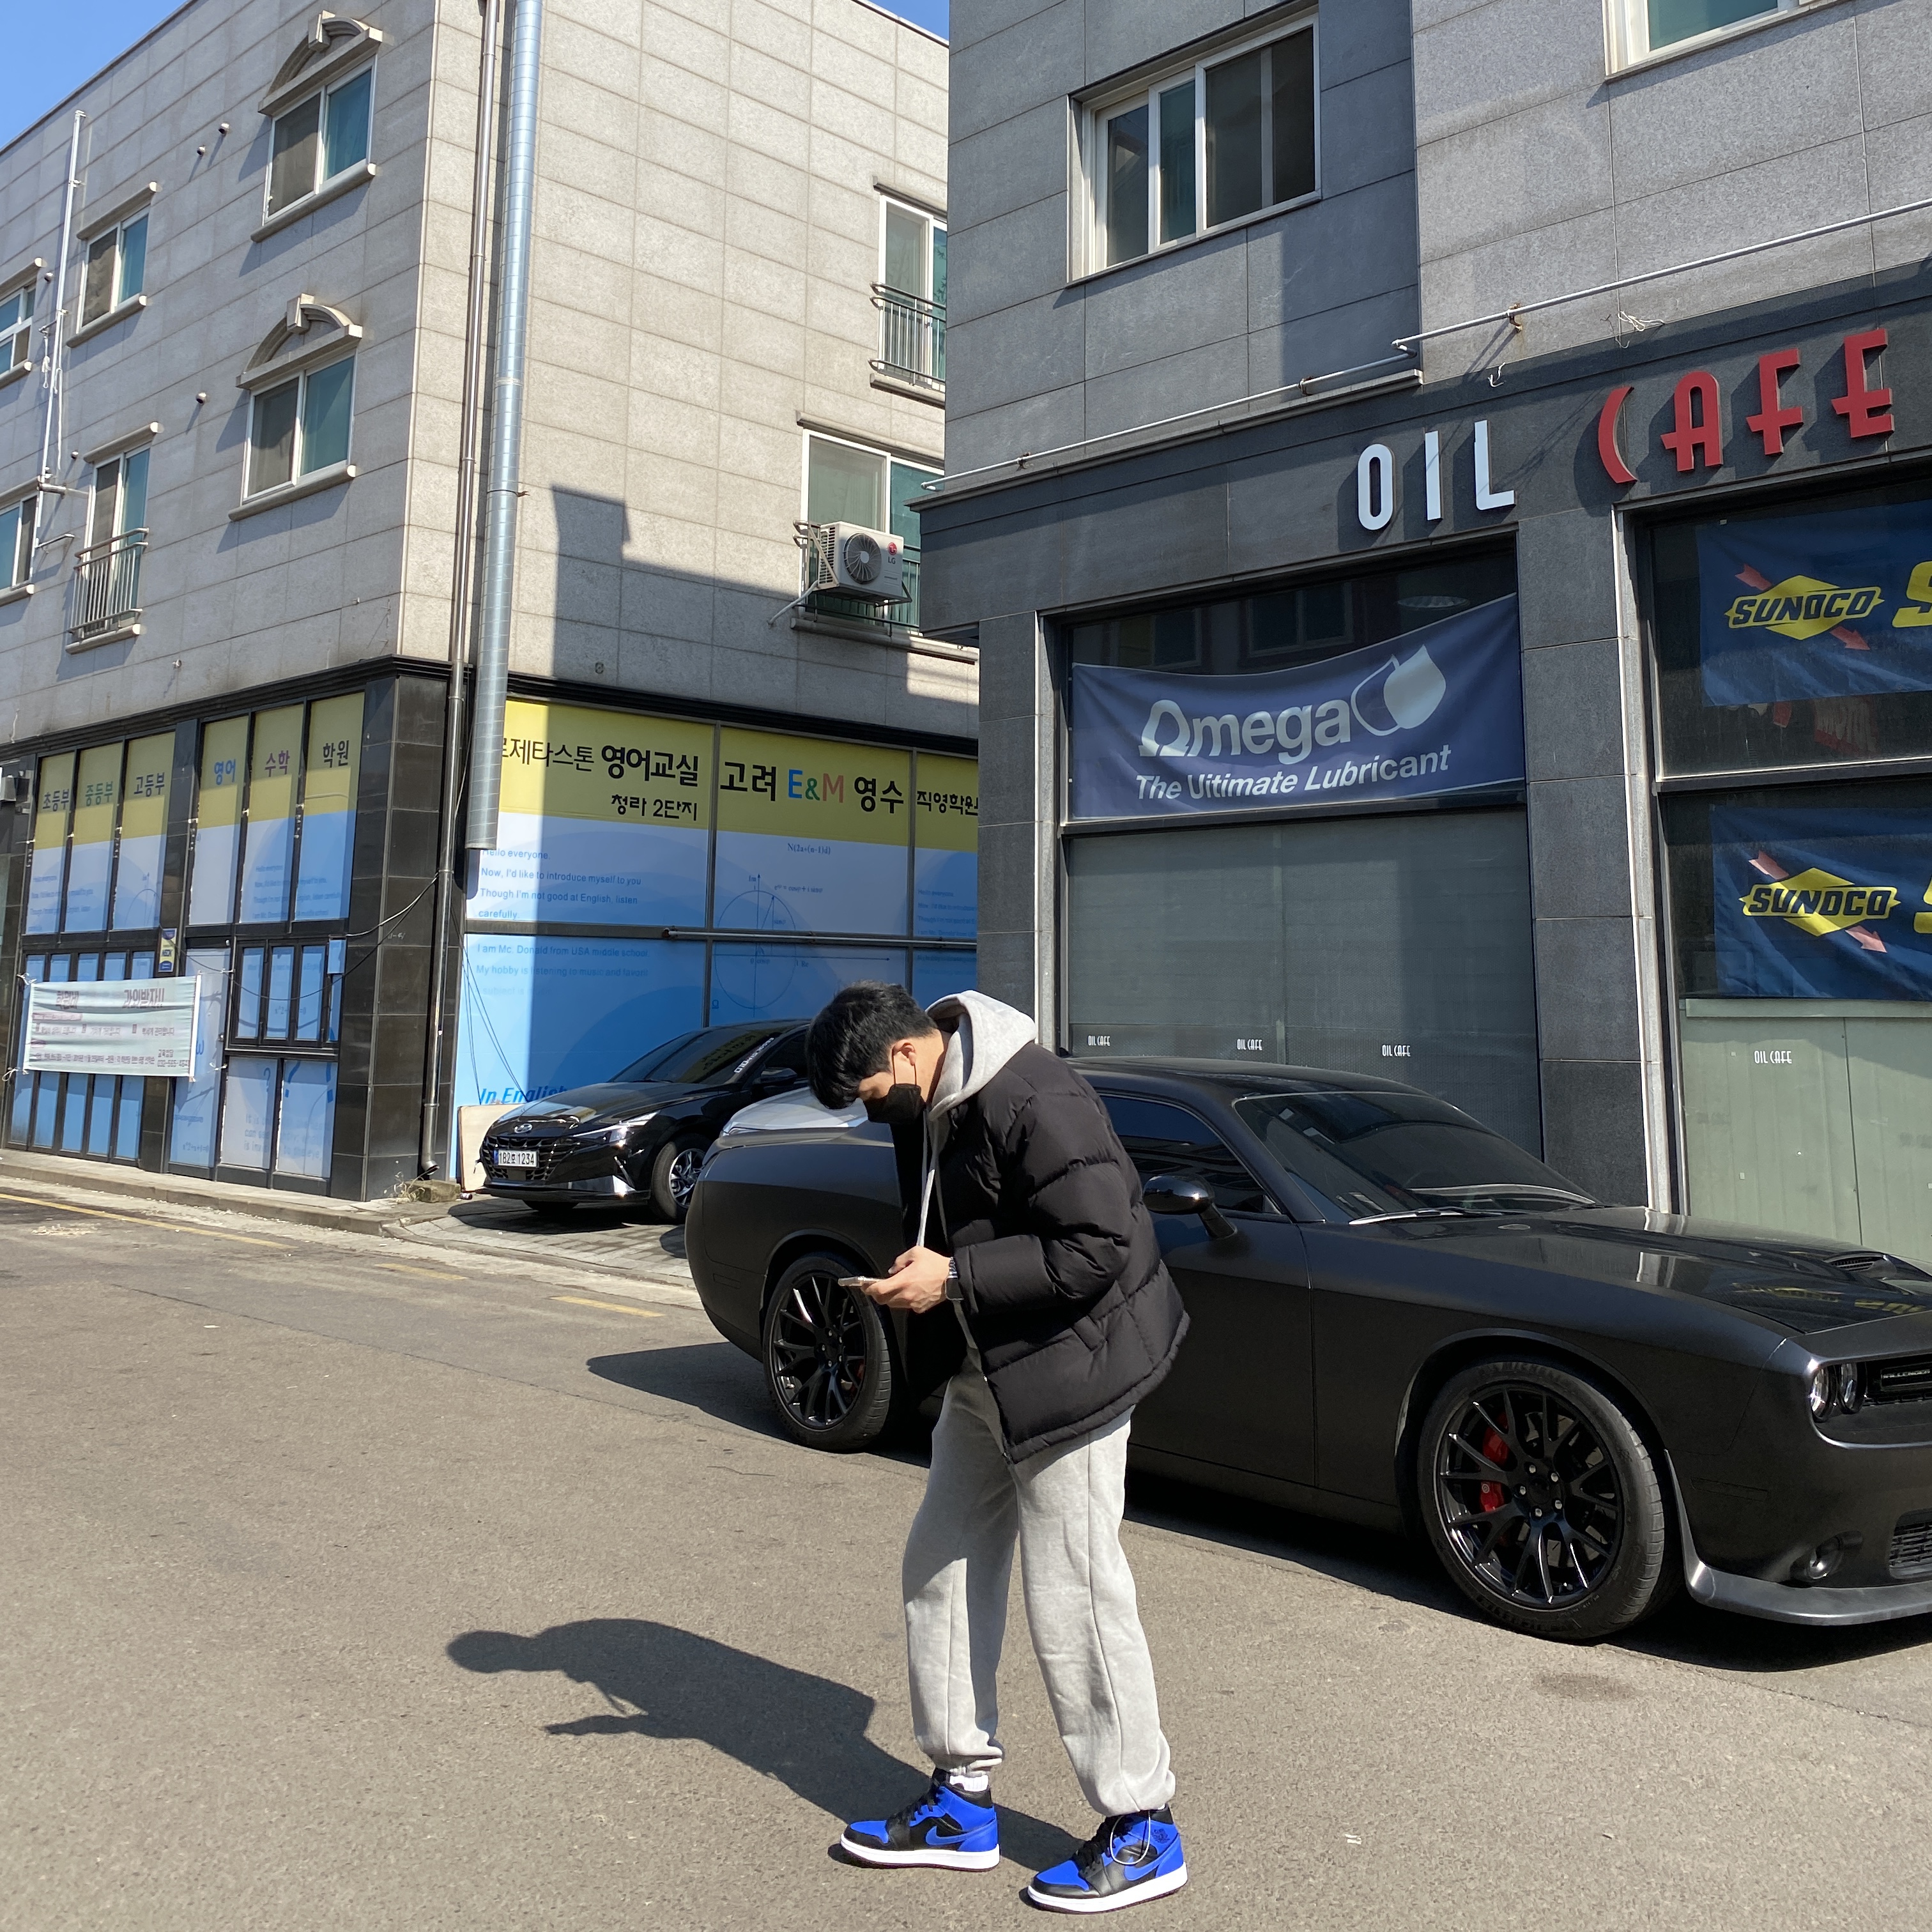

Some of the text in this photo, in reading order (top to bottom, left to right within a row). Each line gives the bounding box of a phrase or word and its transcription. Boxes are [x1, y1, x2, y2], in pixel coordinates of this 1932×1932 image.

[1358, 328, 1894, 532] OIL CAFE
[1732, 590, 1876, 625] SUNOCO
[264, 750, 290, 778] 수학
[323, 740, 350, 768] 학원
[601, 745, 698, 787] 영어교실
[214, 758, 236, 785] 영어
[1136, 775, 1182, 799] The
[1304, 744, 1452, 792] Lubricant
[85, 781, 113, 807] 중등부
[134, 772, 165, 797] 고등부
[720, 761, 904, 814] 고려 E&M 영수
[42, 788, 70, 811] 초등부
[611, 794, 697, 821] 청라 2단지
[519, 870, 534, 879] like
[537, 871, 544, 880] to
[546, 871, 586, 882] introduce
[588, 875, 616, 884] myself
[617, 876, 625, 884] to
[480, 887, 514, 900] Though
[531, 892, 545, 900] not
[547, 893, 568, 902] good
[615, 895, 638, 905] listen
[1749, 890, 1892, 916] SUNOCO
[517, 946, 548, 954] Donald
[549, 947, 569, 956] from
[571, 947, 590, 956] USA
[592, 947, 620, 957] middle
[476, 965, 490, 976] My
[491, 965, 519, 976] hobby
[1088, 1035, 1110, 1046] OIL CAFE
[1237, 1039, 1262, 1050] OIL CAFE
[1382, 1045, 1411, 1057] OIL CAFE
[1754, 1050, 1792, 1064] OIL CAFE
[480, 1088, 497, 1104] In
[518, 1153, 535, 1165] 1234
